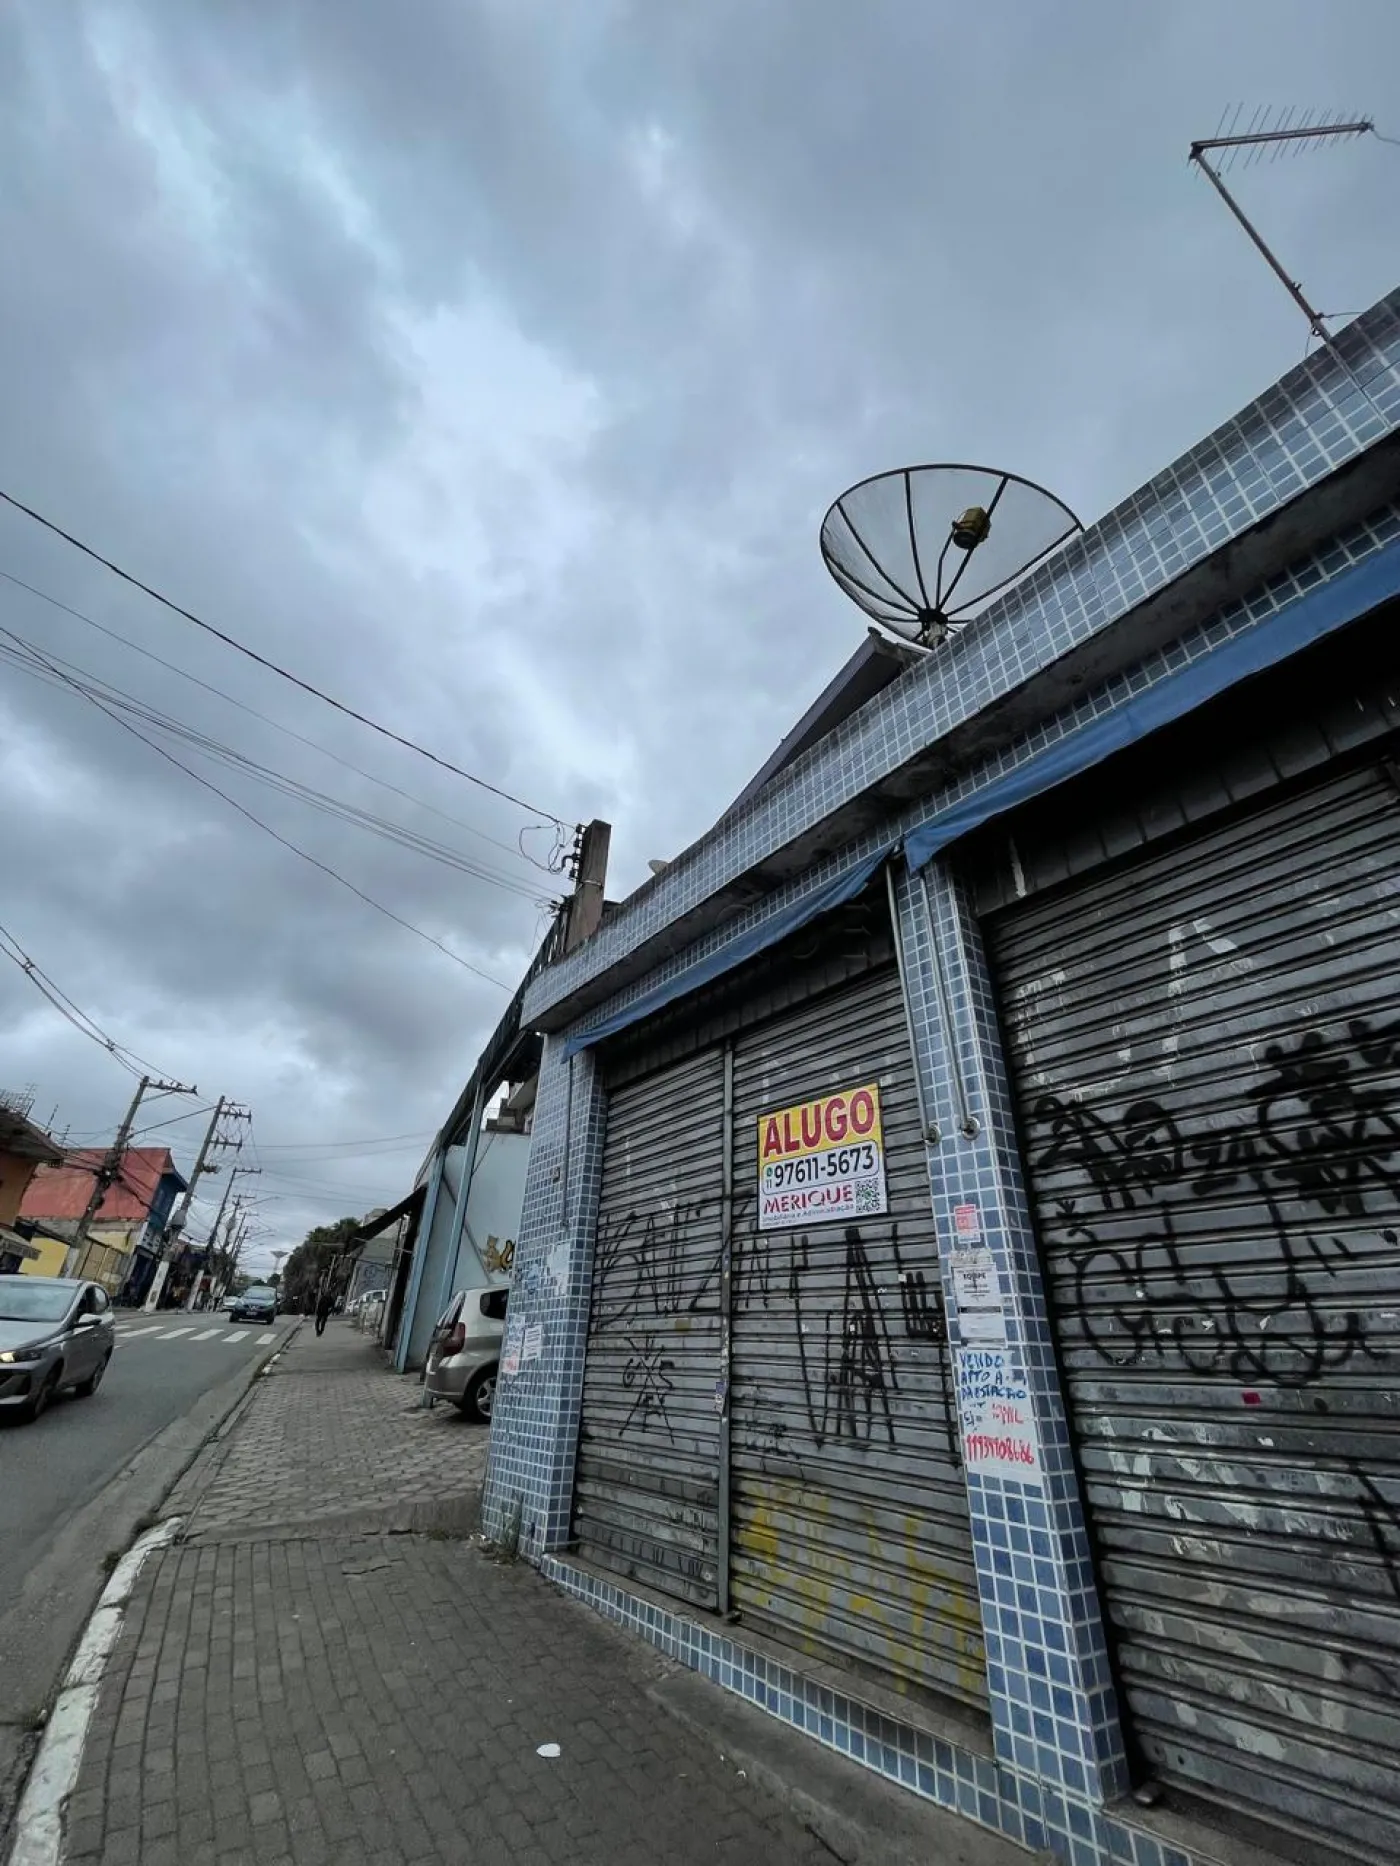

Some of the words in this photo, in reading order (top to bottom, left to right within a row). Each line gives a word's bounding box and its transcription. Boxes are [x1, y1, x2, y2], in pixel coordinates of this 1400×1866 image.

[763, 1090, 875, 1158] ALUGO
[774, 1145, 874, 1188] 97611-5673
[764, 1184, 853, 1214] MERIQUE
[960, 1352, 1004, 1369] VENDO
